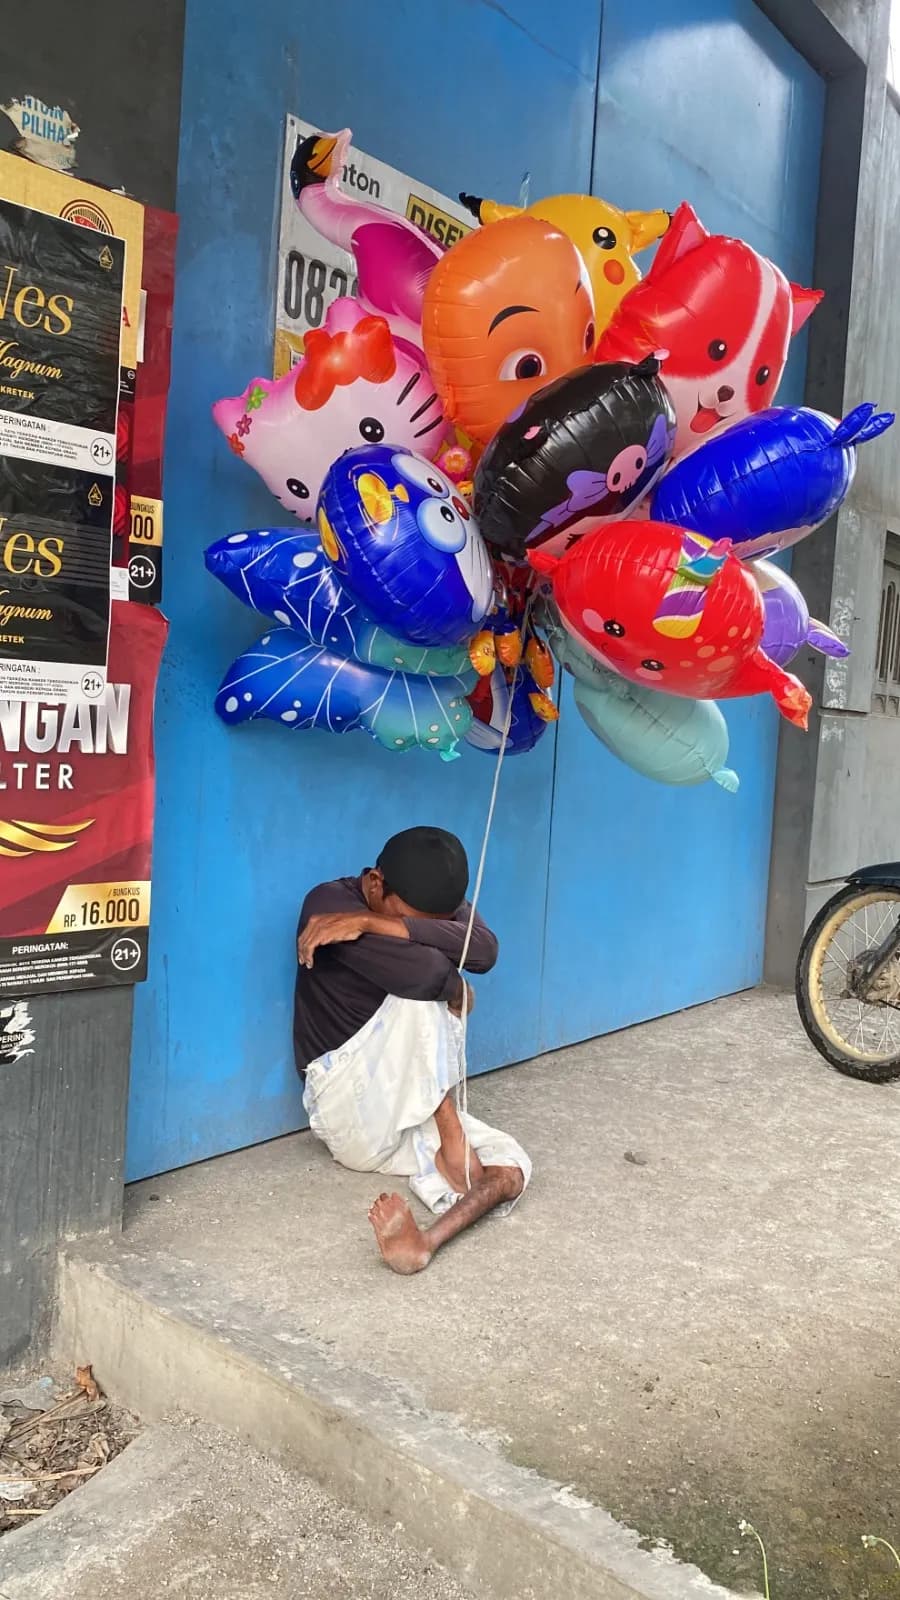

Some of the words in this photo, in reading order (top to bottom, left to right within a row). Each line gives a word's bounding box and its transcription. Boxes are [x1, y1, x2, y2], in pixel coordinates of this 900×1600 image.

[22, 111, 70, 143] PILIHA
[1, 386, 35, 399] KRETEK
[93, 444, 110, 458] 21+
[130, 514, 154, 540] 00
[130, 564, 153, 578] 21+
[84, 678, 101, 690] 21+
[81, 898, 139, 926] 16.000
[114, 947, 138, 961] 21+
